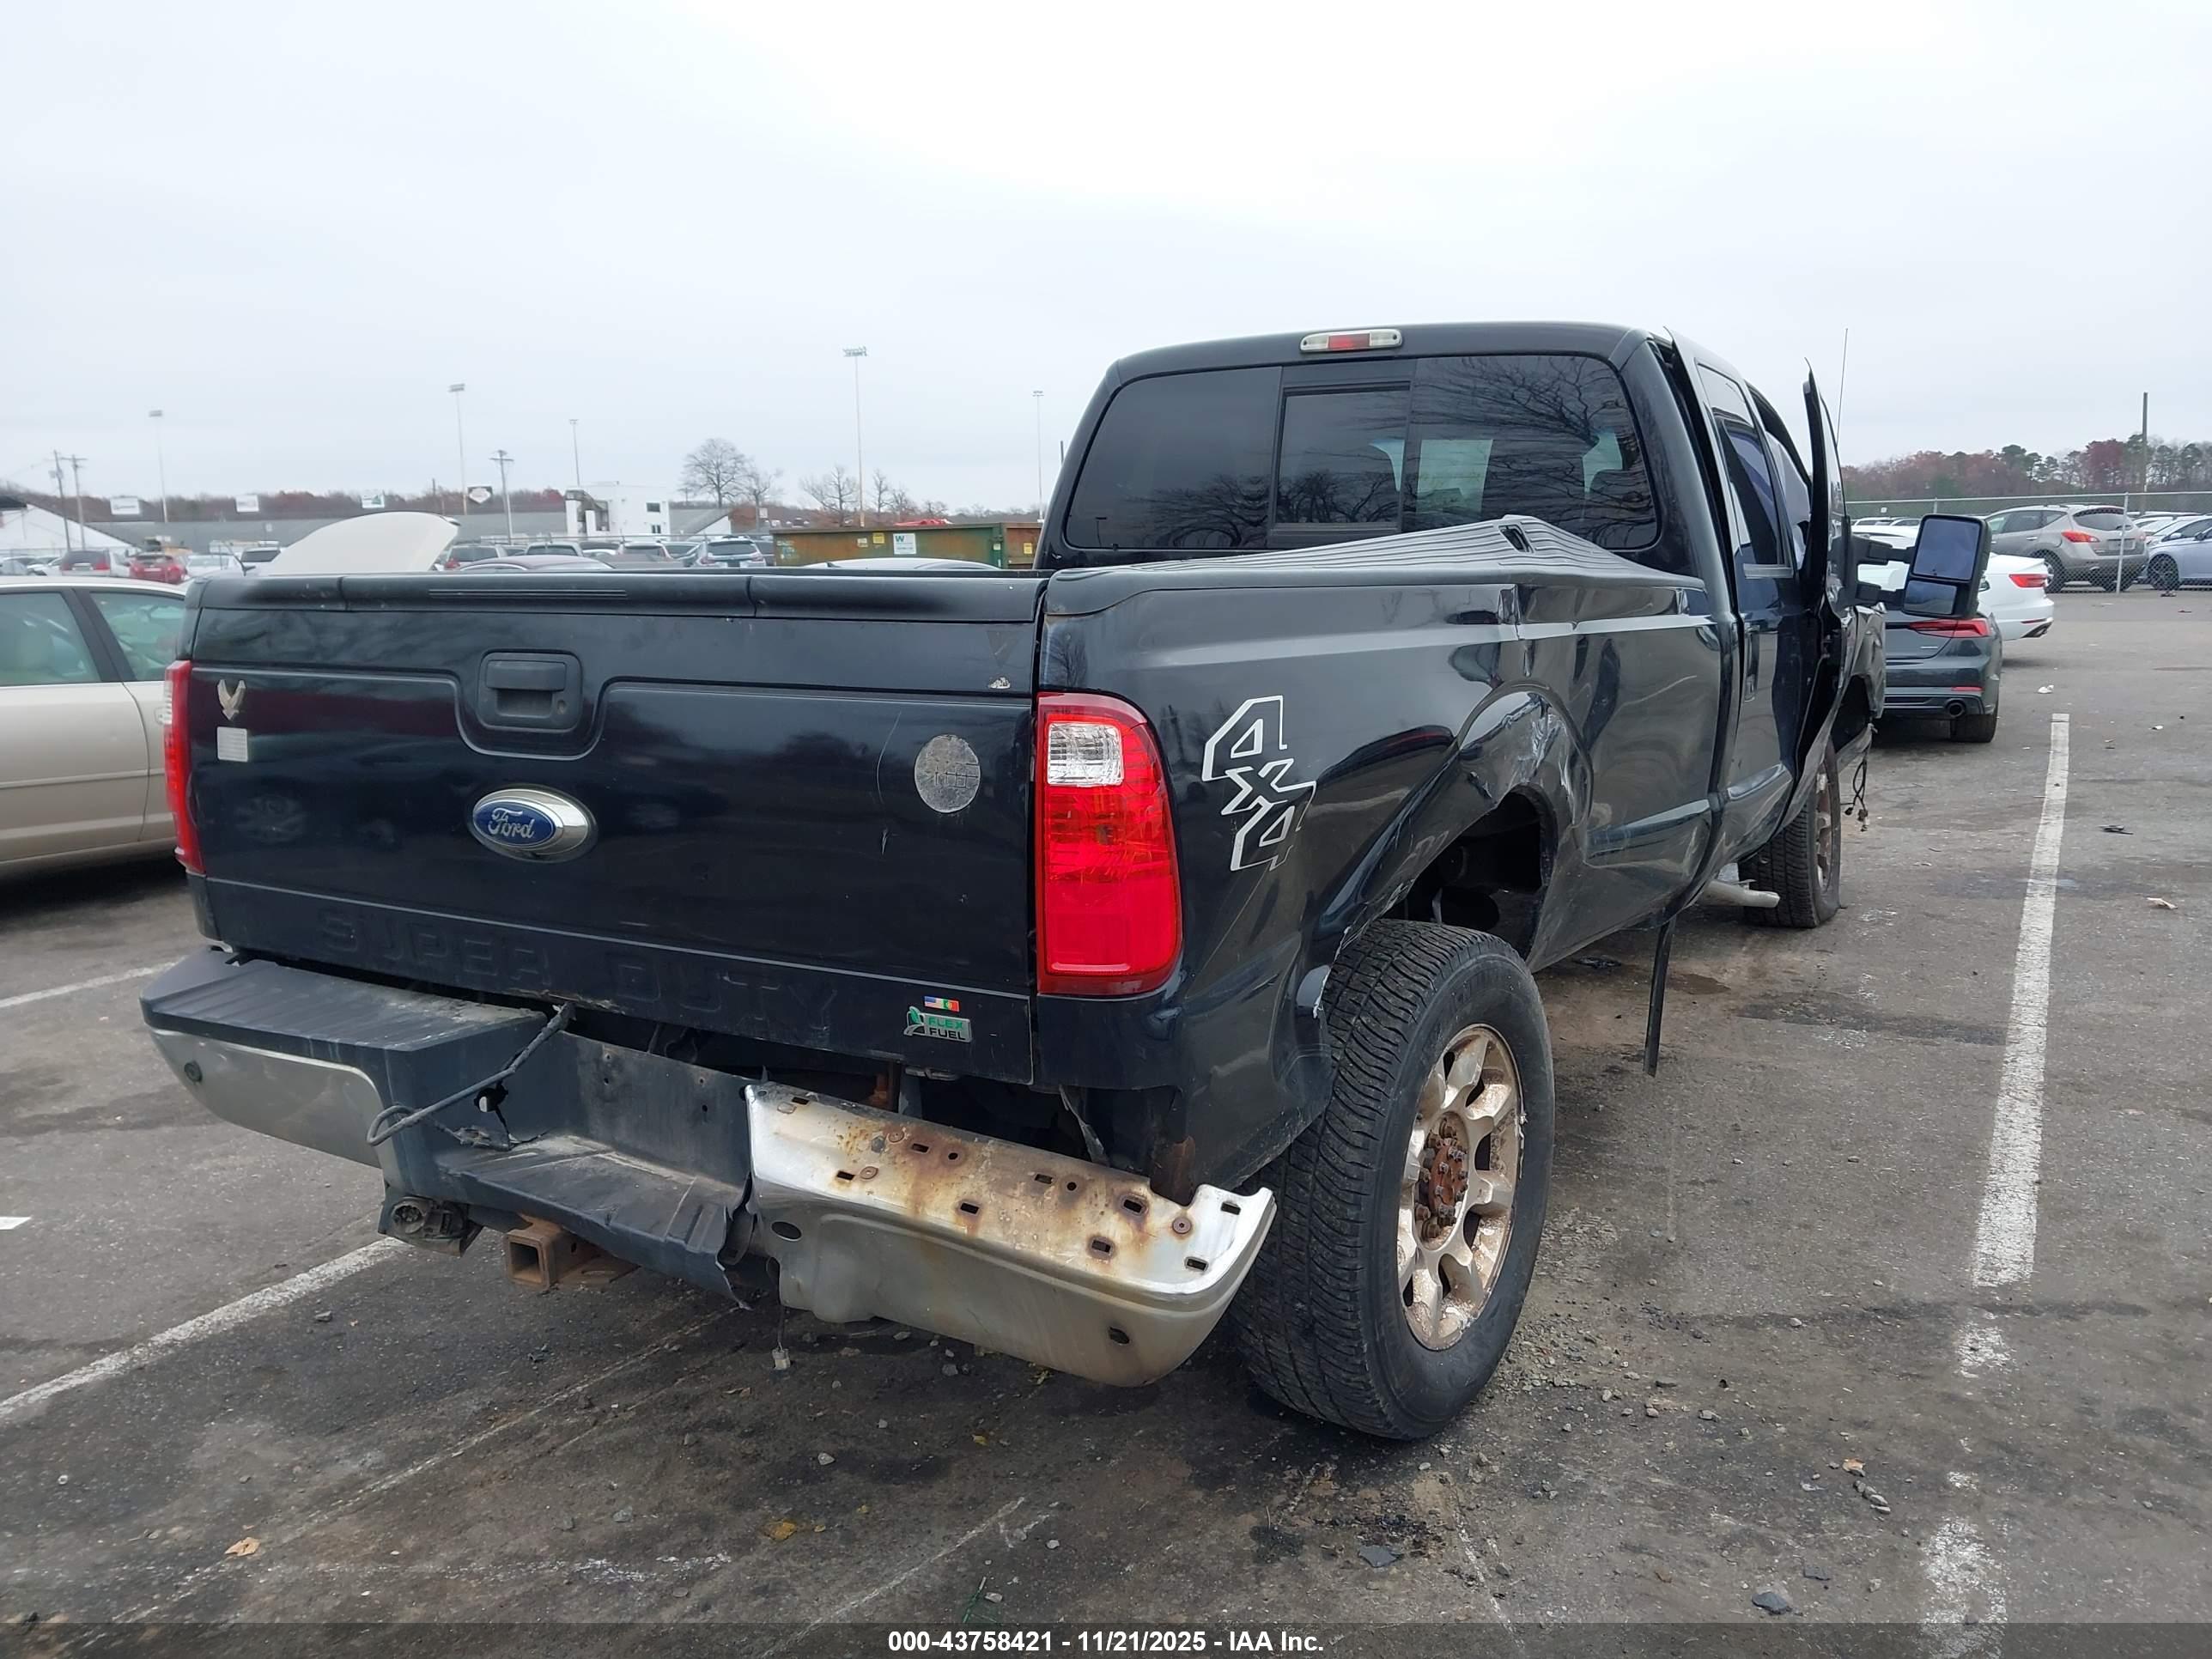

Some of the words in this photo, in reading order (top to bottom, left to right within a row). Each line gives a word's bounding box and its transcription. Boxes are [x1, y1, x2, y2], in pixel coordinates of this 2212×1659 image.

[488, 807, 535, 838] Ford
[928, 1017, 963, 1029] FLEX
[929, 1027, 966, 1041] FUEL
